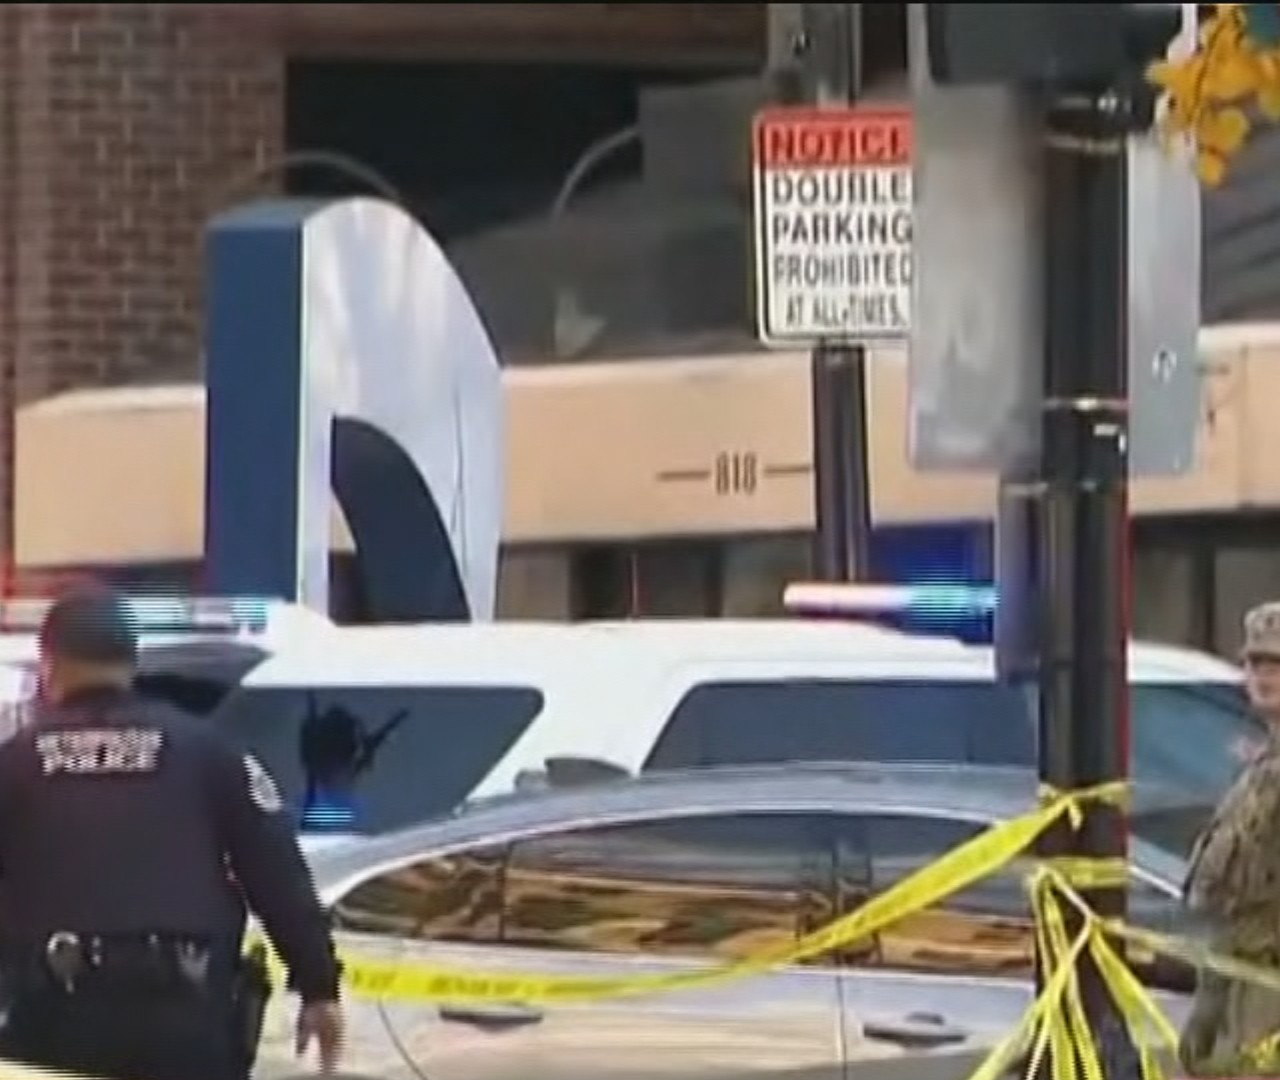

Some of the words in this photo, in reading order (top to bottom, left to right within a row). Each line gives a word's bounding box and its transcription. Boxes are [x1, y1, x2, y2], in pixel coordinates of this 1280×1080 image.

[773, 172, 911, 205] DOUBLE
[773, 211, 912, 245] PARKING
[774, 253, 912, 286] PROHIBITED
[786, 293, 805, 327] AT
[716, 451, 757, 496] 818
